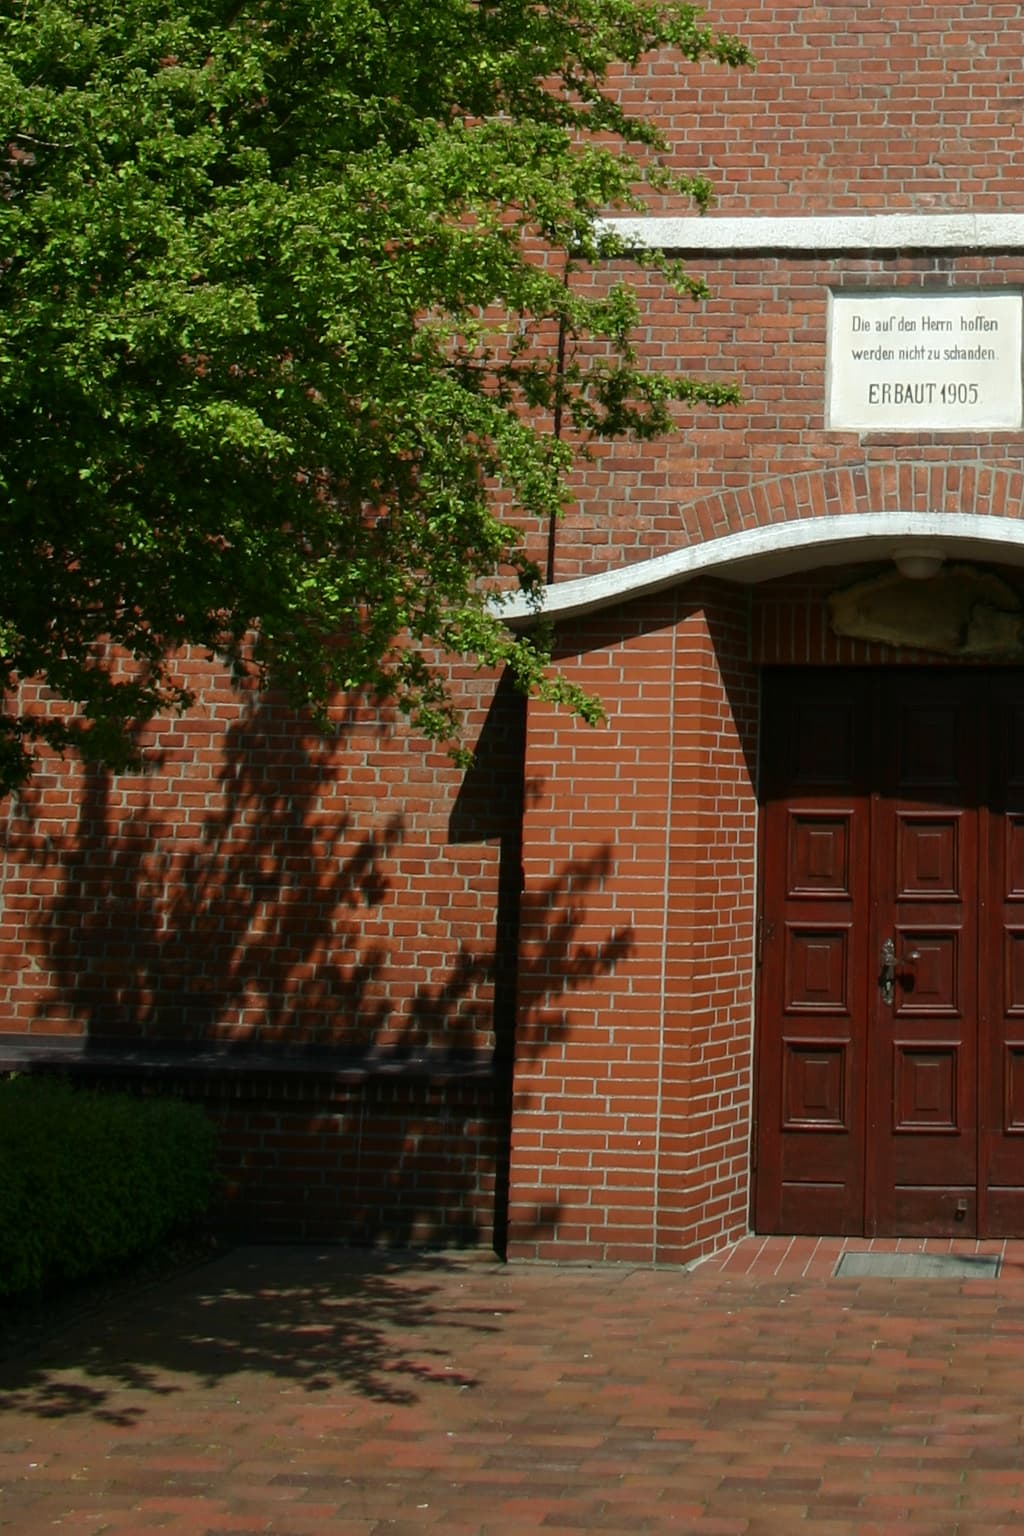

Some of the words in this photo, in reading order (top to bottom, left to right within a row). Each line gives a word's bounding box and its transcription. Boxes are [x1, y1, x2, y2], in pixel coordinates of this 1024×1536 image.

[852, 316, 871, 332] Die
[875, 316, 896, 332] auf
[898, 316, 917, 332] den
[921, 316, 953, 332] Herrn
[960, 315, 999, 332] hoffen
[851, 345, 895, 362] werden
[898, 345, 925, 361] nicht
[927, 347, 941, 361] zu
[868, 383, 937, 405] ERBAUT
